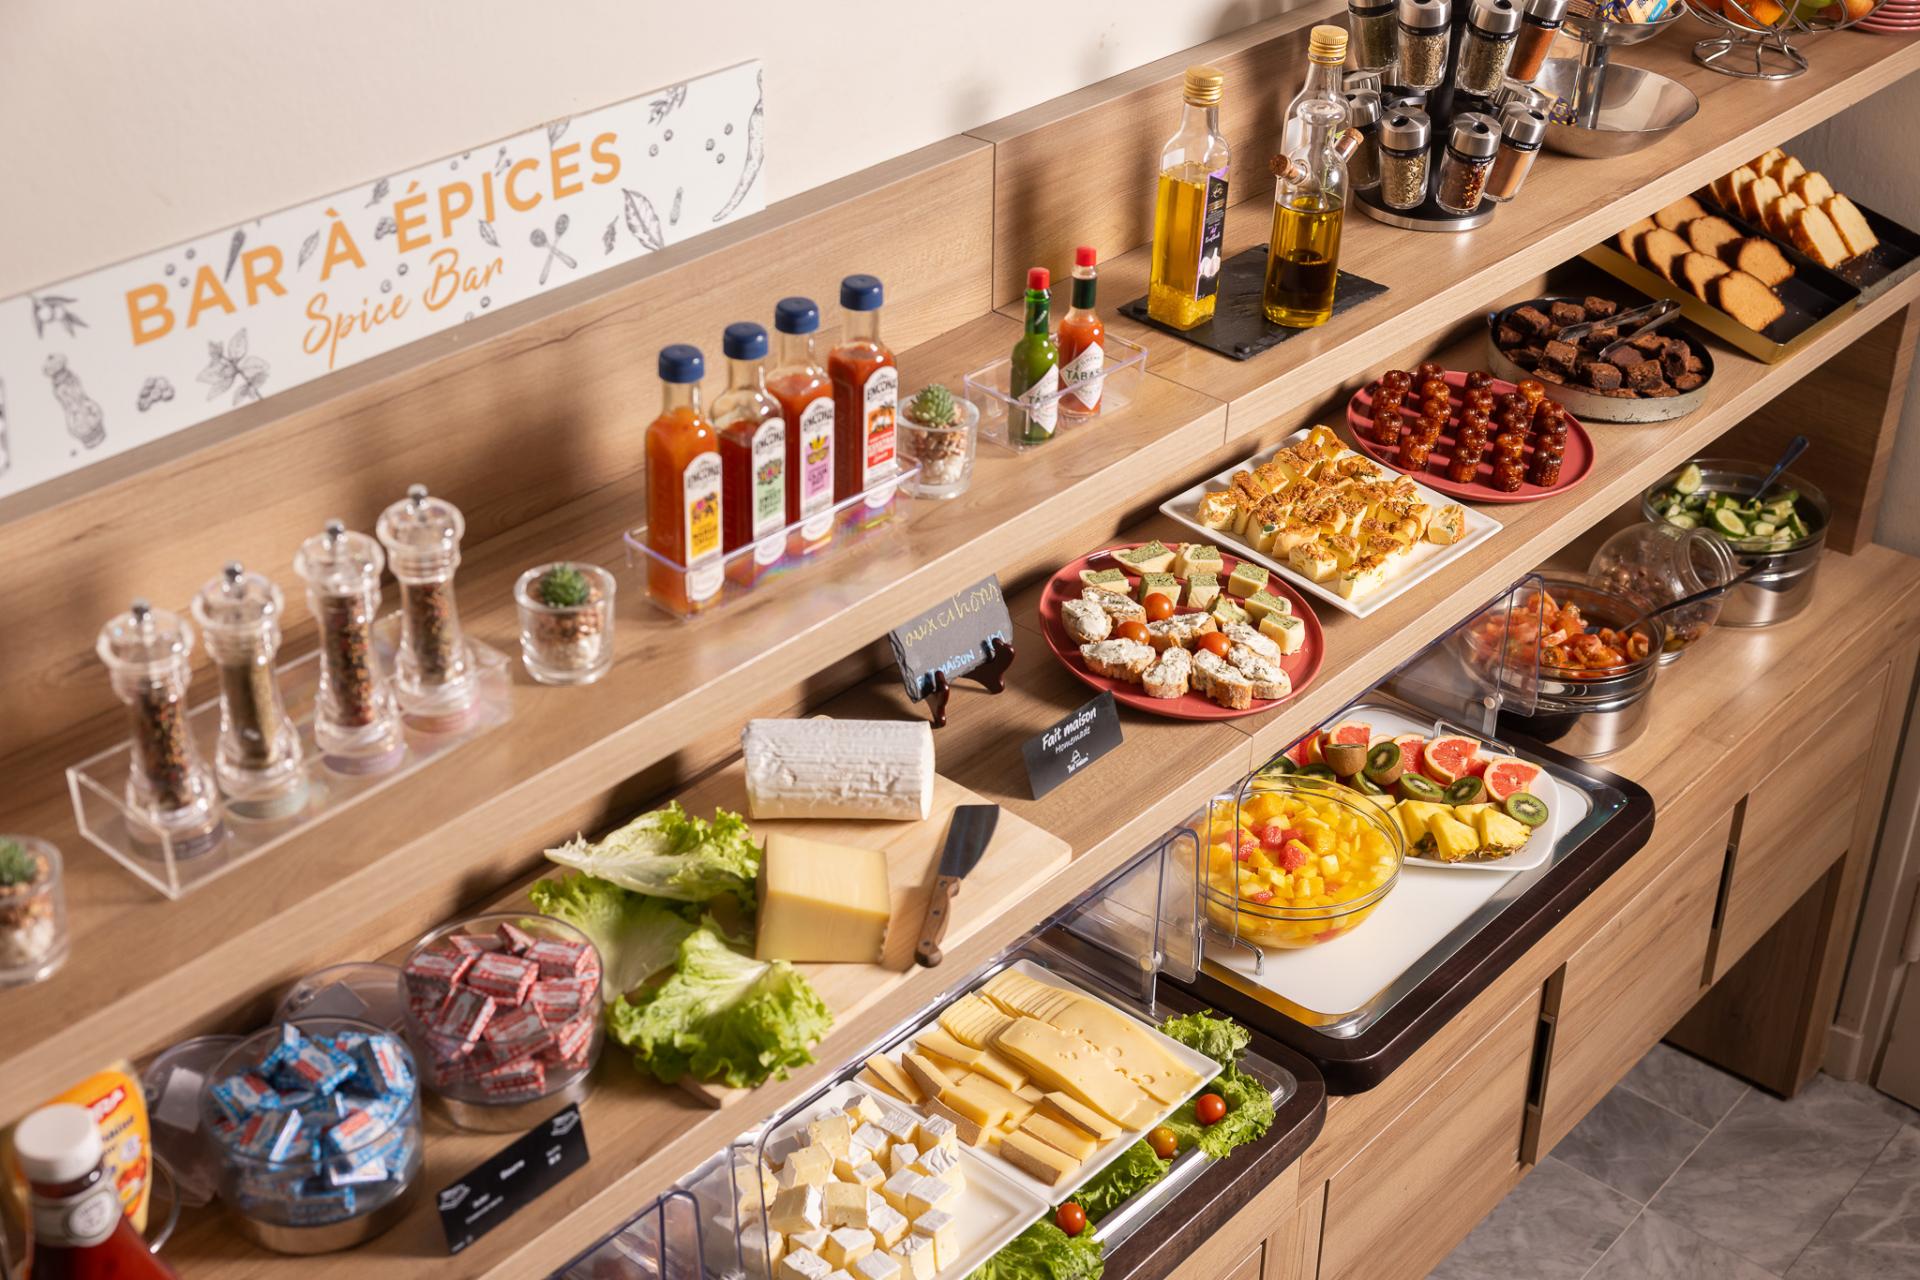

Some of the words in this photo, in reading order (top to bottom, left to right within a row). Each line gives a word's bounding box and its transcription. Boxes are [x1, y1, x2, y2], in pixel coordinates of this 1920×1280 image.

[124, 244, 288, 347] BAR
[319, 206, 367, 282] À
[393, 131, 622, 254] ÉPICES
[302, 291, 411, 370] Spice
[422, 247, 504, 312] Bar
[1041, 726, 1062, 751] Fait
[1062, 706, 1097, 738] maison
